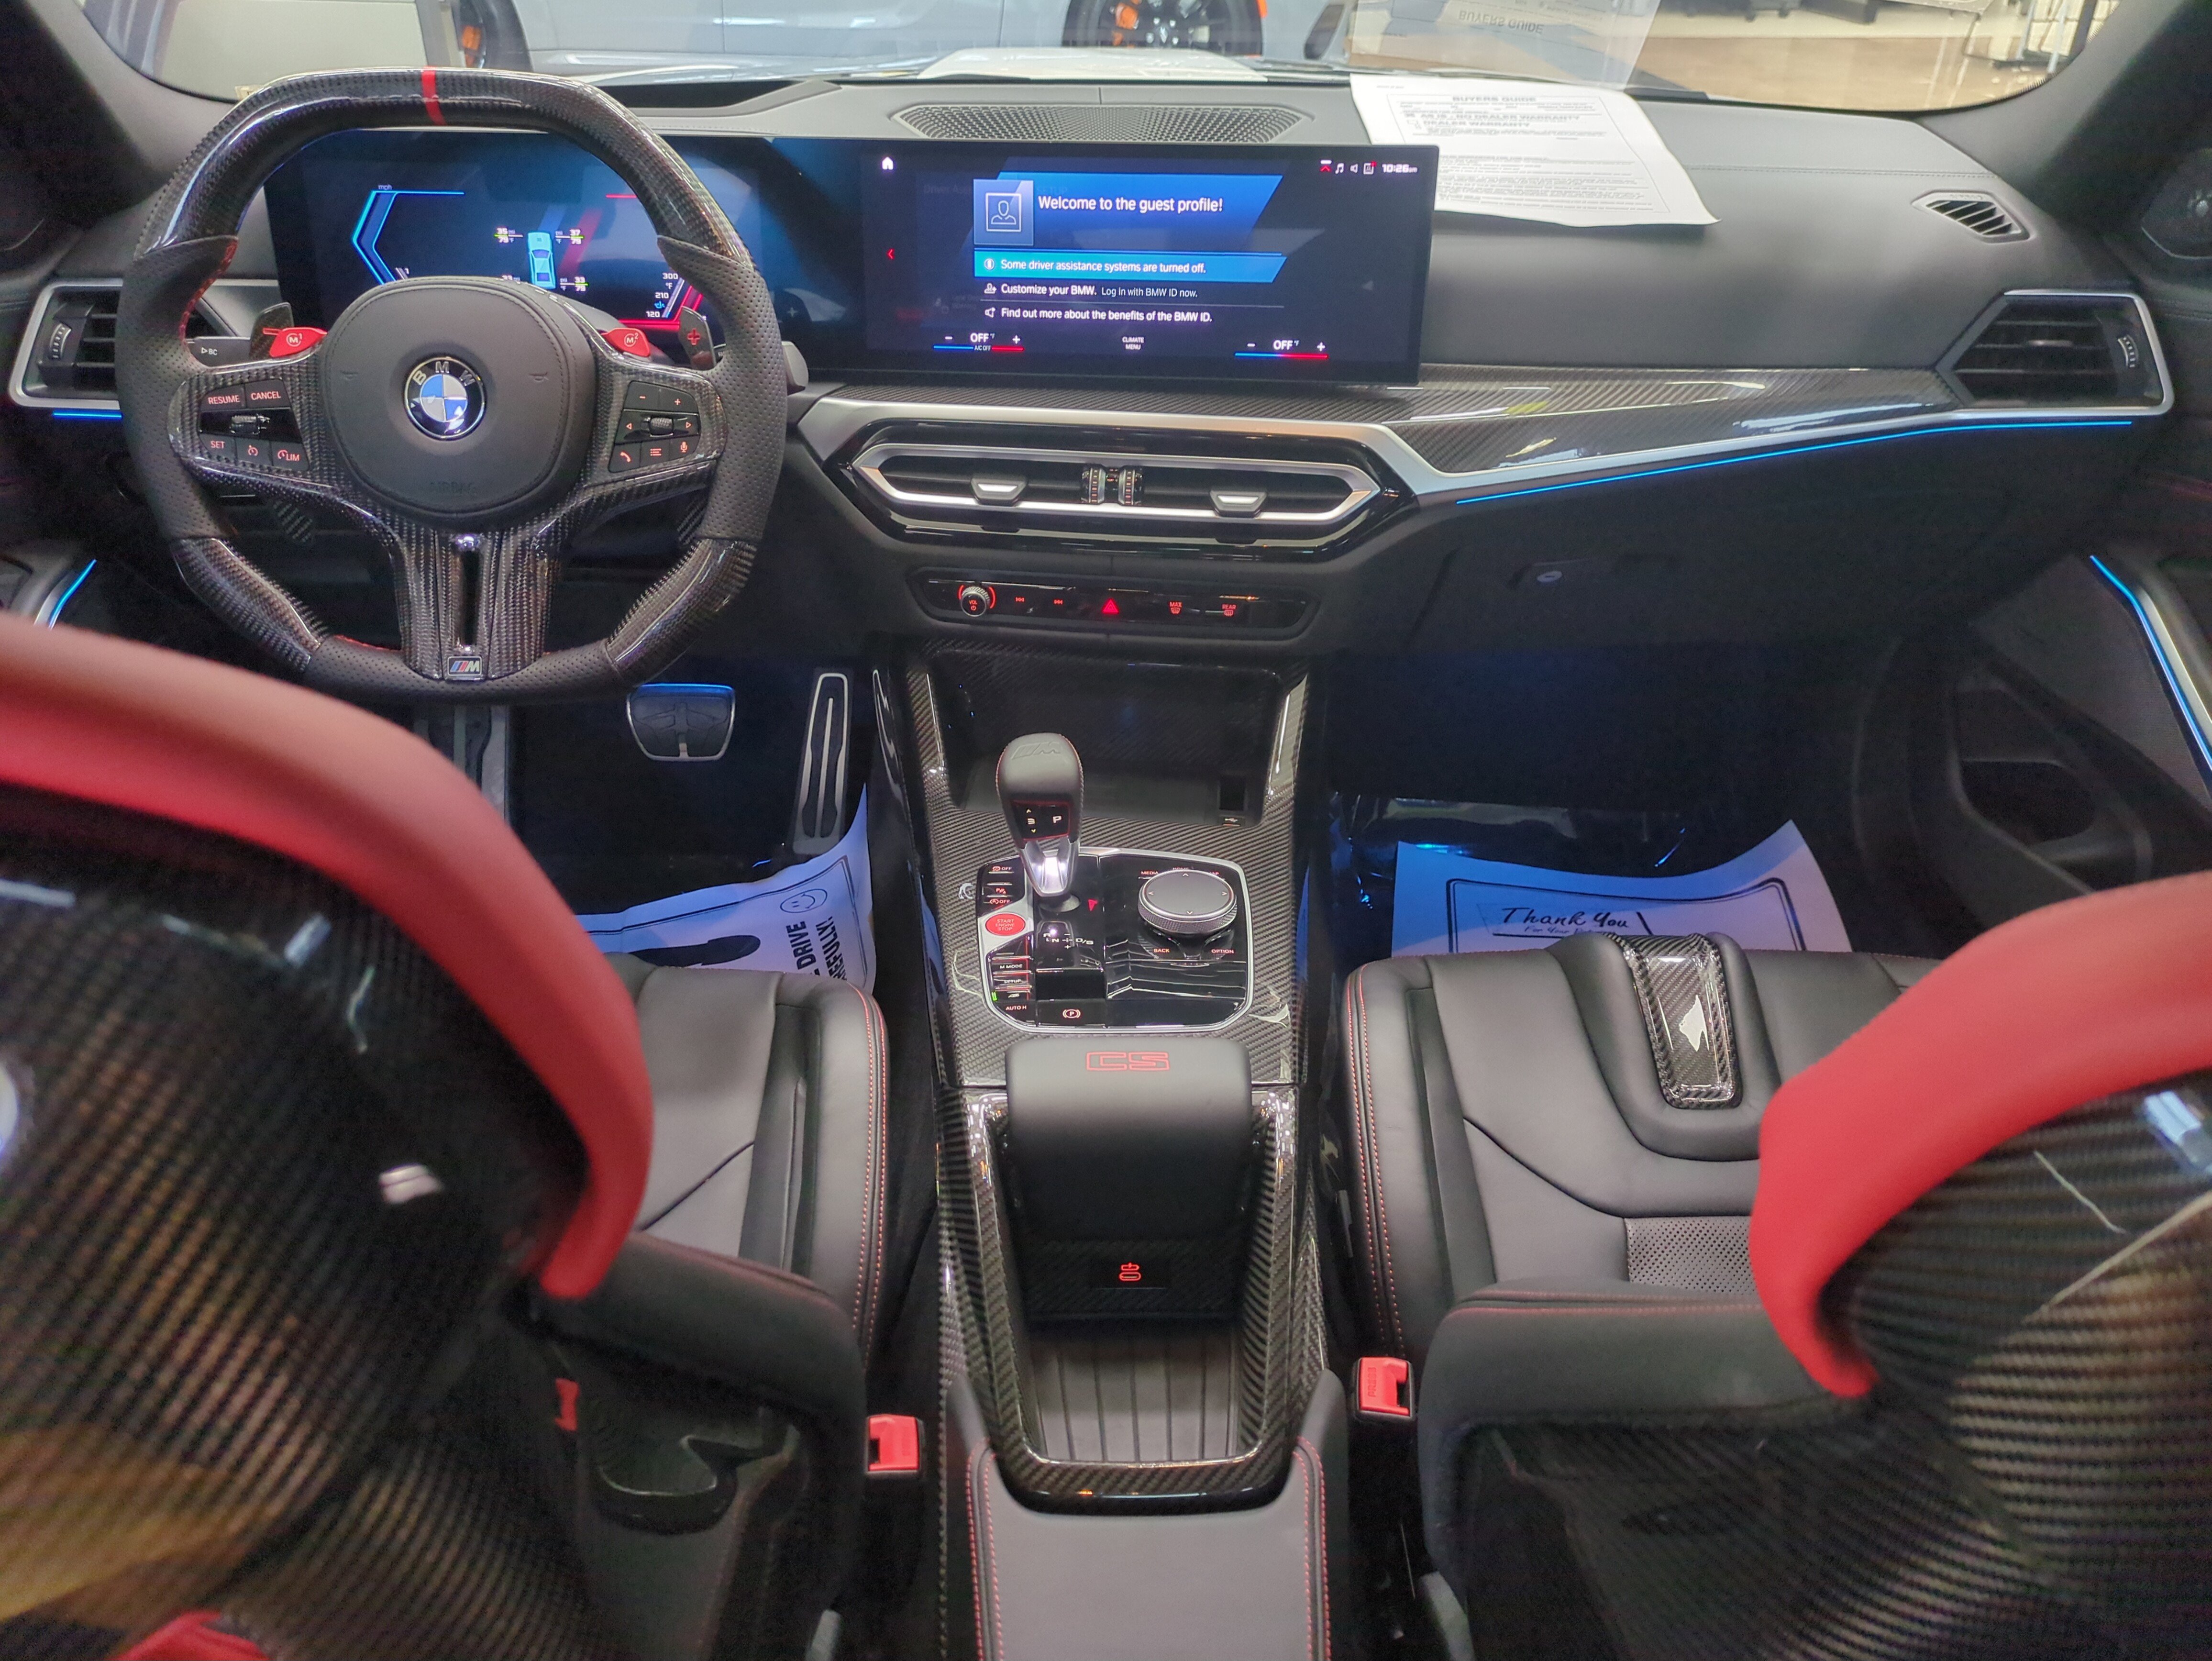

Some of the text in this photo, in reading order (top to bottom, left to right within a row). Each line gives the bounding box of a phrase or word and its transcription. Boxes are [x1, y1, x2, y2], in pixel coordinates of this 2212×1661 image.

[1038, 195, 1223, 214] Welcome to the guest profile!
[1001, 259, 1206, 273] Some driver assistance systems are turned off.
[1001, 283, 1097, 296] Customize your BMW.
[1101, 287, 1117, 297] Log
[1127, 288, 1144, 296] with
[1145, 288, 1166, 297] BMW
[1169, 288, 1177, 297] ID
[1179, 289, 1198, 298] now.
[1001, 308, 1021, 318] Find
[1022, 310, 1038, 318] out
[1064, 310, 1090, 320] about
[1092, 311, 1106, 320] the
[1108, 310, 1145, 321] benefits
[1146, 311, 1156, 321] of
[1157, 311, 1172, 321] the
[1173, 311, 1199, 322] BMW
[1200, 312, 1213, 322] ID.
[970, 332, 989, 343] OFF
[1273, 340, 1294, 350] OFF
[412, 361, 476, 386] BMW
[208, 395, 240, 405] RESUME
[251, 391, 281, 401] CANCEL
[210, 440, 225, 449] SET
[286, 454, 300, 462] LIM
[1052, 815, 1062, 823] P
[1502, 907, 1629, 928] Thank You
[785, 921, 817, 970] DRIVE
[815, 916, 848, 981] REFULLY!
[1086, 1052, 1170, 1071] CS
